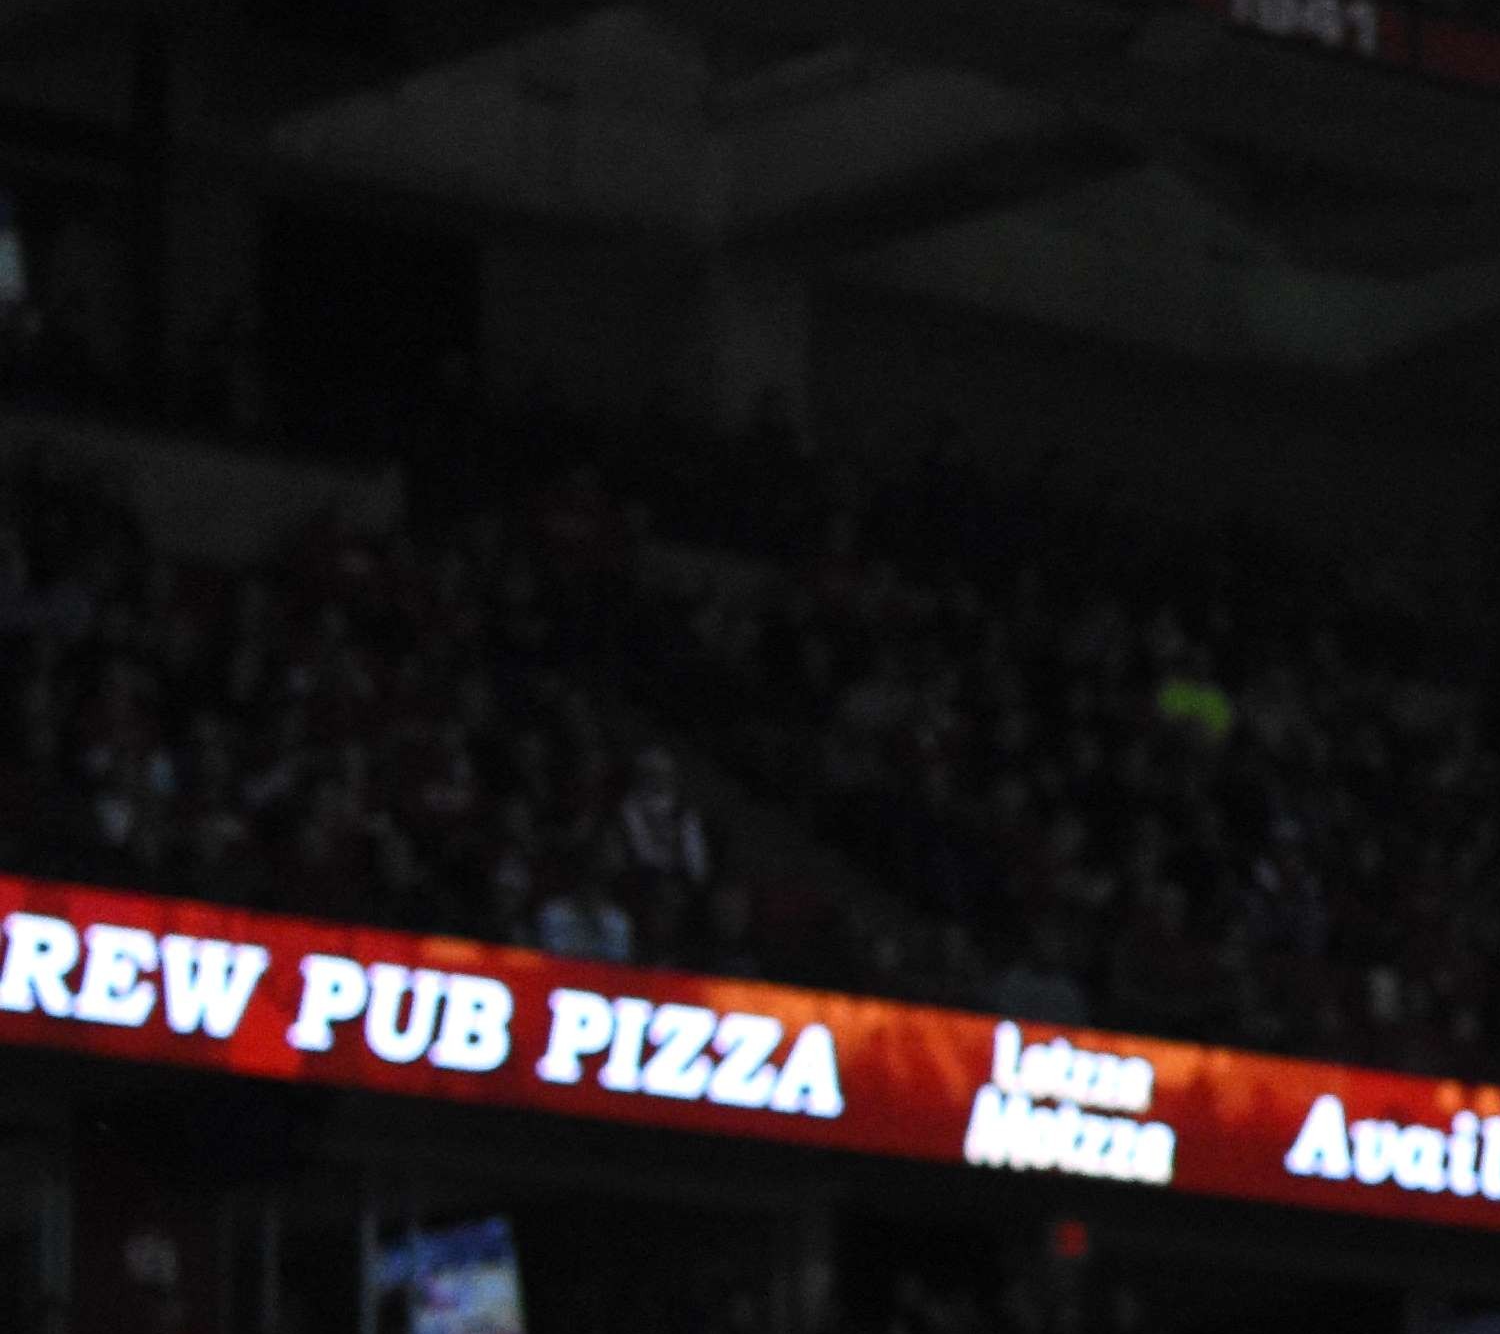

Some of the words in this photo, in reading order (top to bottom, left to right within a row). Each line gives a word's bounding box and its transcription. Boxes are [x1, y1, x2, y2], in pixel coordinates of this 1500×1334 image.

[0, 911, 270, 1039] REW
[286, 951, 515, 1072] PUB
[537, 986, 844, 1119] PIZZA
